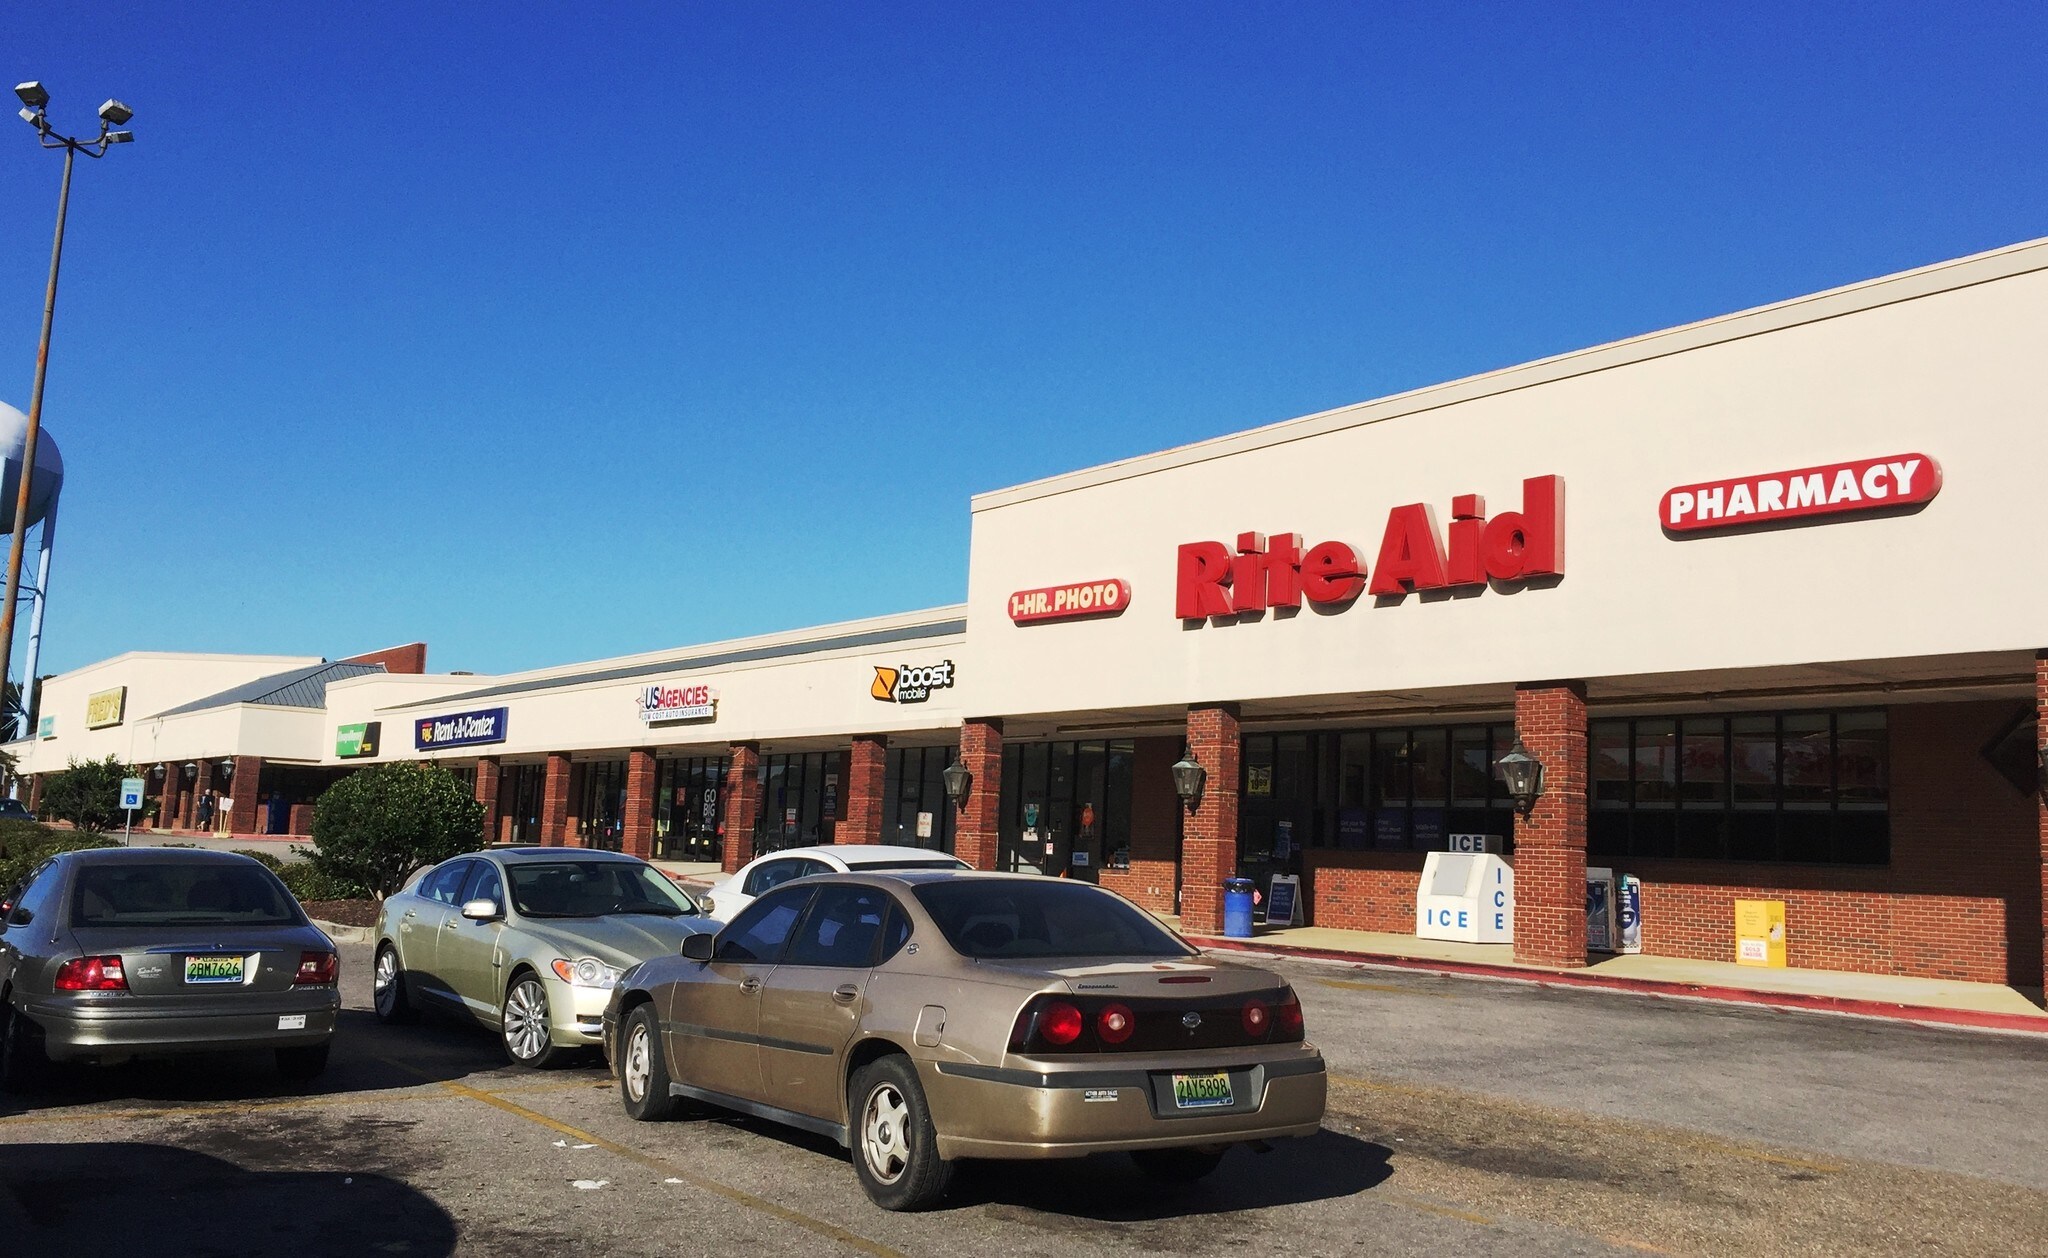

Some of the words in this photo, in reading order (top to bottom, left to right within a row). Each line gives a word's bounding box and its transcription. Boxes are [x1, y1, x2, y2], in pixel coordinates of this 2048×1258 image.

[1670, 459, 1921, 524] PHARMACY
[1176, 531, 1368, 620] Rite
[1369, 474, 1565, 596] Aid
[1012, 593, 1053, 617] 1-HR.
[1054, 583, 1118, 611] PHOTO
[900, 660, 953, 688] boost
[899, 688, 927, 700] mobile
[652, 710, 665, 719] COST
[666, 709, 678, 718] AUTO
[679, 707, 708, 717] INSURANCE
[704, 788, 717, 803] GO
[703, 803, 716, 817] BIG
[1452, 836, 1483, 852] ICE
[1494, 867, 1505, 930] ICE
[1427, 908, 1468, 928] ICE
[190, 962, 239, 976] 2BM7626
[1178, 1078, 1228, 1098] 2AY5898
